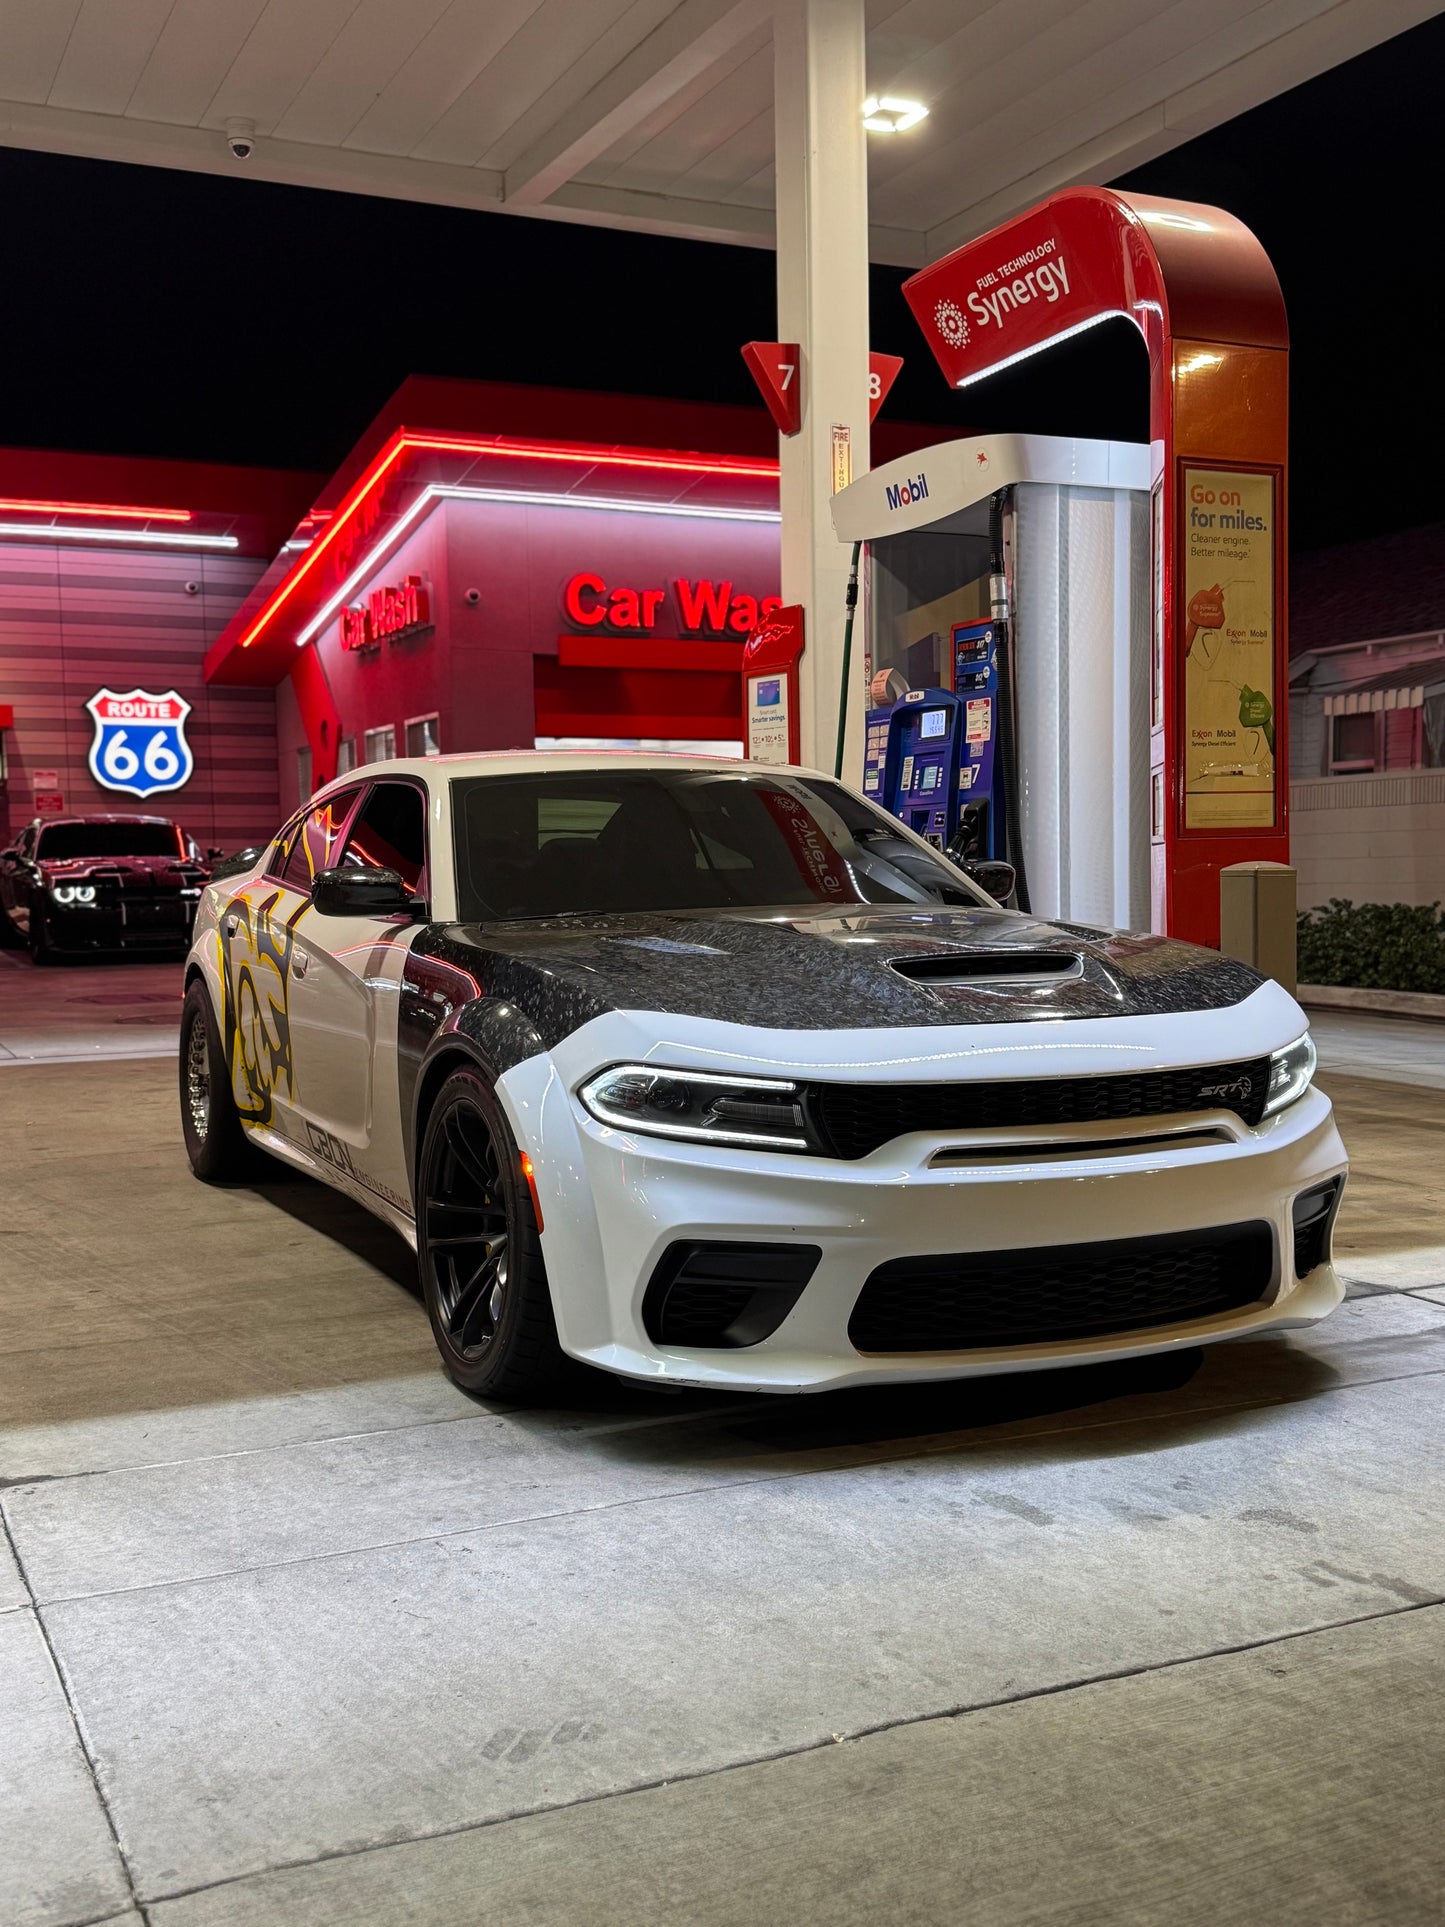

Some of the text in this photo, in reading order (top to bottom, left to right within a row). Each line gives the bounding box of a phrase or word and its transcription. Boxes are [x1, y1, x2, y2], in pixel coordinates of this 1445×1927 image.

[976, 238, 1057, 291] FUEL TECHNOLOGY
[967, 256, 1071, 329] Synergy
[777, 364, 795, 391] 7
[869, 372, 882, 400] 8
[833, 431, 849, 442] FIRE
[886, 473, 929, 511] Mobil
[1190, 484, 1241, 507] Go on
[1190, 507, 1268, 532] for miles.
[1190, 533, 1221, 545] Cleaner
[1190, 547, 1216, 558] Better
[567, 573, 664, 626] Car
[339, 577, 419, 652] Car Wash
[1226, 628, 1268, 640] Exxon Mobil
[107, 701, 172, 719] ROUTE
[1191, 729, 1236, 740] Exxon Mobil
[103, 729, 180, 781] 66
[972, 763, 981, 784] 7
[1198, 1082, 1242, 1097] SRT
[353, 1166, 413, 1214] ENGINEERING
